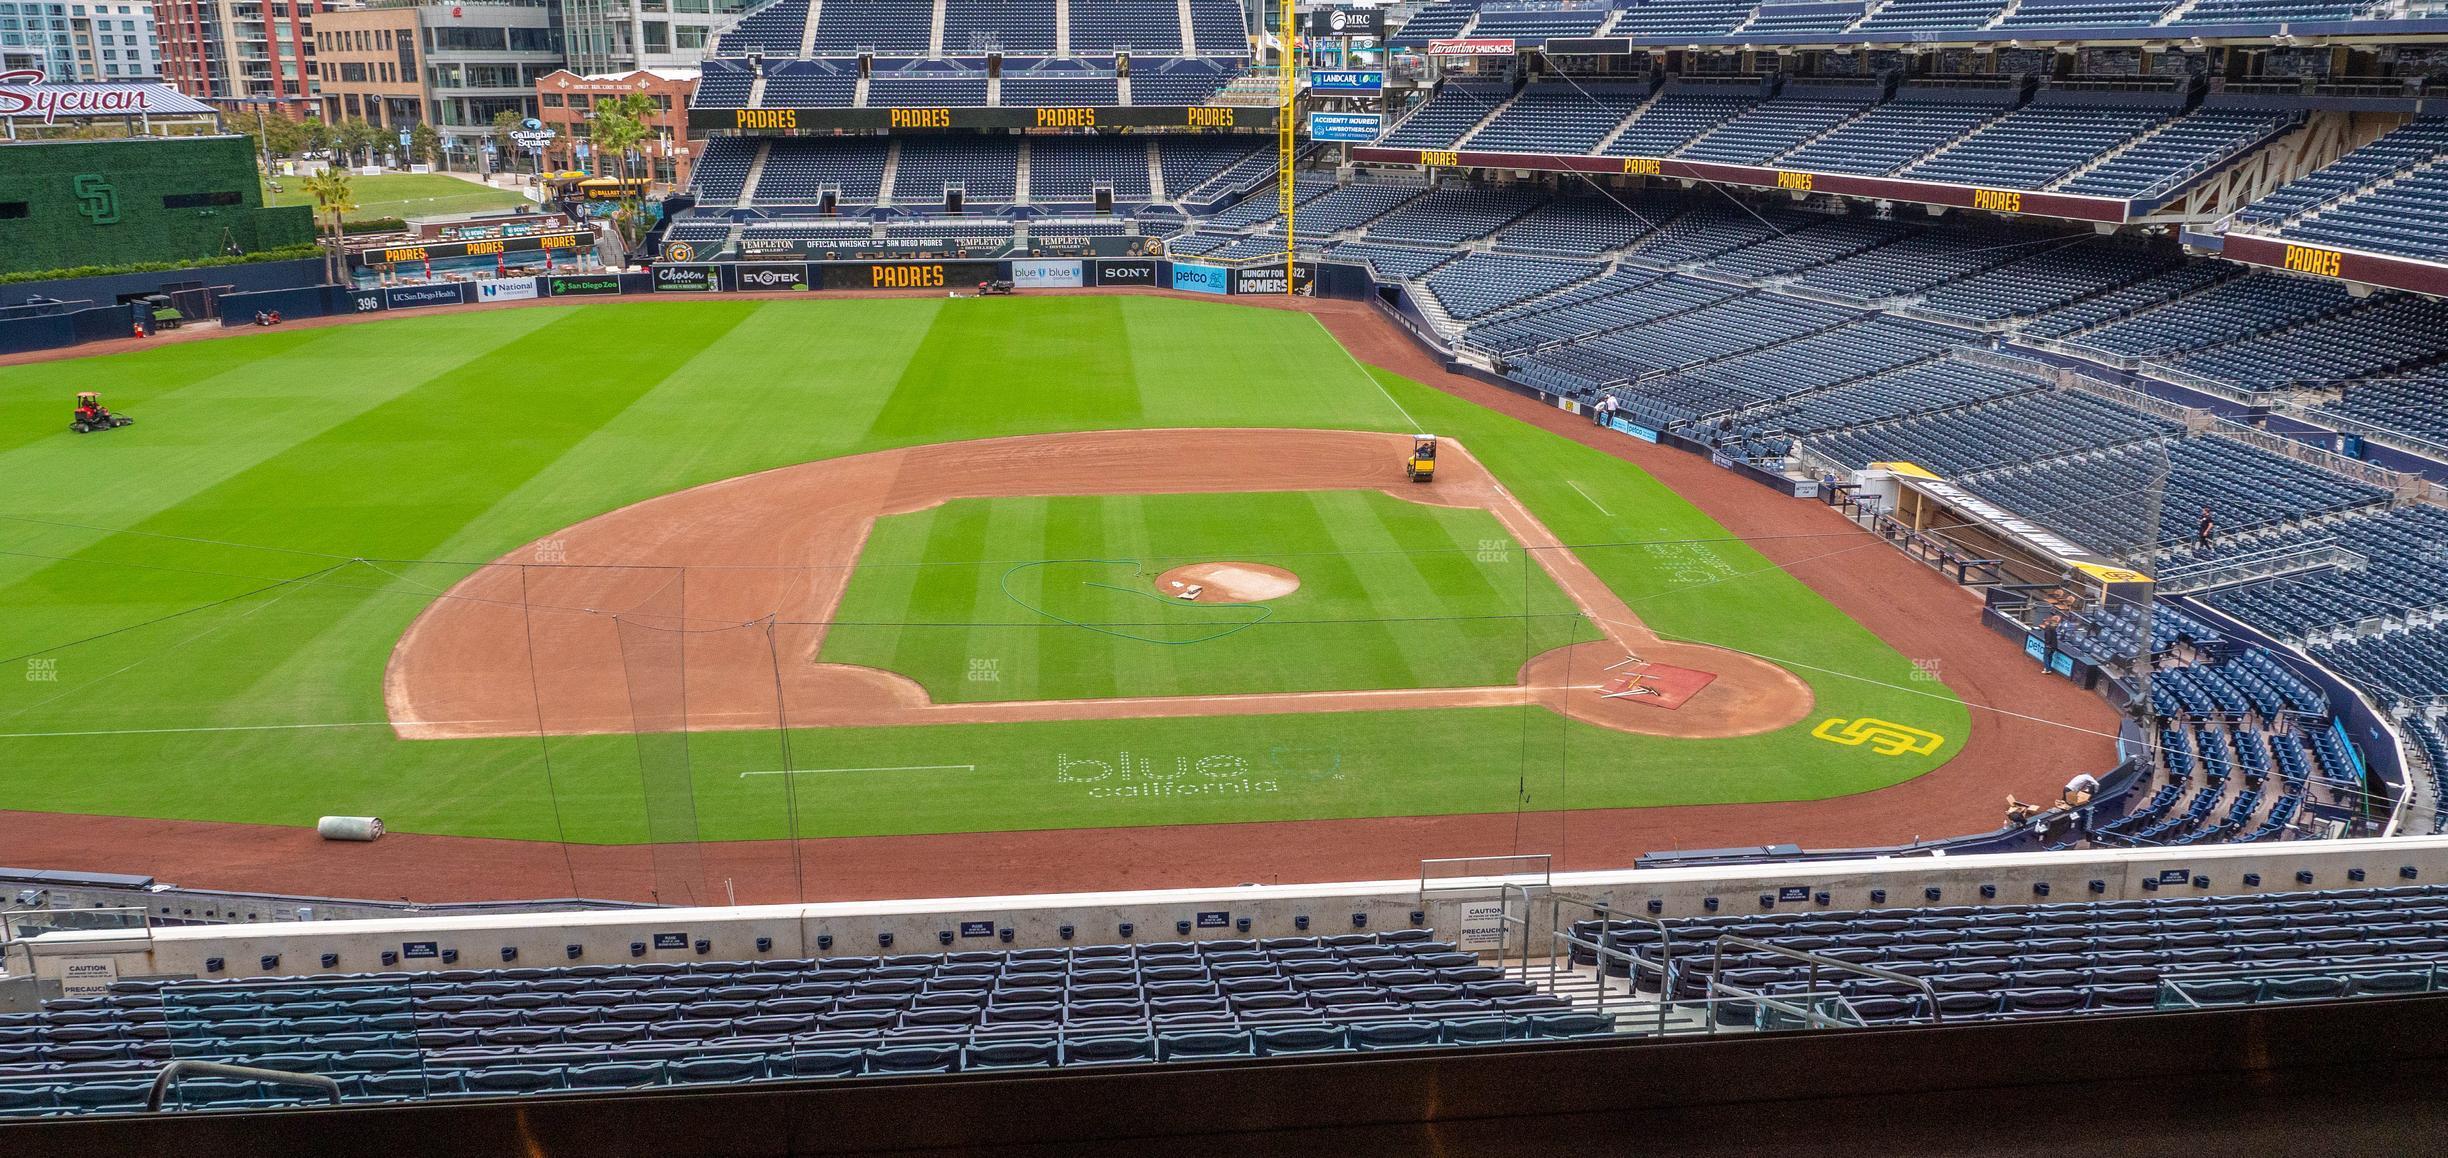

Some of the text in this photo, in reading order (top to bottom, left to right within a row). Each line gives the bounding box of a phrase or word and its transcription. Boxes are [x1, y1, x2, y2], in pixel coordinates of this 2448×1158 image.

[1346, 14, 1370, 24] MRC
[1430, 42, 1512, 54] Tarantino SAUSAGES
[1323, 74, 1380, 84] LANDCARE LOGIC
[0, 69, 152, 126] Sycuan
[736, 109, 796, 128] PADRES
[891, 108, 950, 127] PADRES
[1037, 108, 1095, 126] PADRES
[1188, 107, 1233, 126] PADRES
[510, 130, 556, 140] Gallagher
[518, 140, 550, 148] Square
[1421, 152, 1457, 166] PADRES
[1624, 159, 1660, 174] PADRES
[1778, 172, 1812, 190] PADRES
[1974, 189, 2021, 212] PADRES
[467, 241, 504, 255] PADRES
[541, 236, 575, 248] PADRES
[742, 241, 794, 249] TEMPLETON
[1039, 237, 1090, 246] TEMPLETON
[386, 248, 425, 261] PADRES
[2284, 244, 2341, 277] PADRES
[659, 268, 704, 280] Chosen
[744, 270, 800, 285] EVOTEK
[872, 265, 943, 287] PADRES
[1016, 268, 1070, 276] blue blue
[1106, 268, 1150, 278] SONY
[1176, 270, 1207, 283] petco
[1293, 267, 1304, 278] 322
[499, 282, 533, 291] National
[1240, 279, 1288, 292] HOMERS
[417, 292, 435, 301] Diego
[435, 290, 456, 299] Health
[358, 297, 378, 311] 396
[1628, 425, 1643, 436] petco
[1058, 752, 1248, 782] blue
[1088, 777, 1278, 797] california
